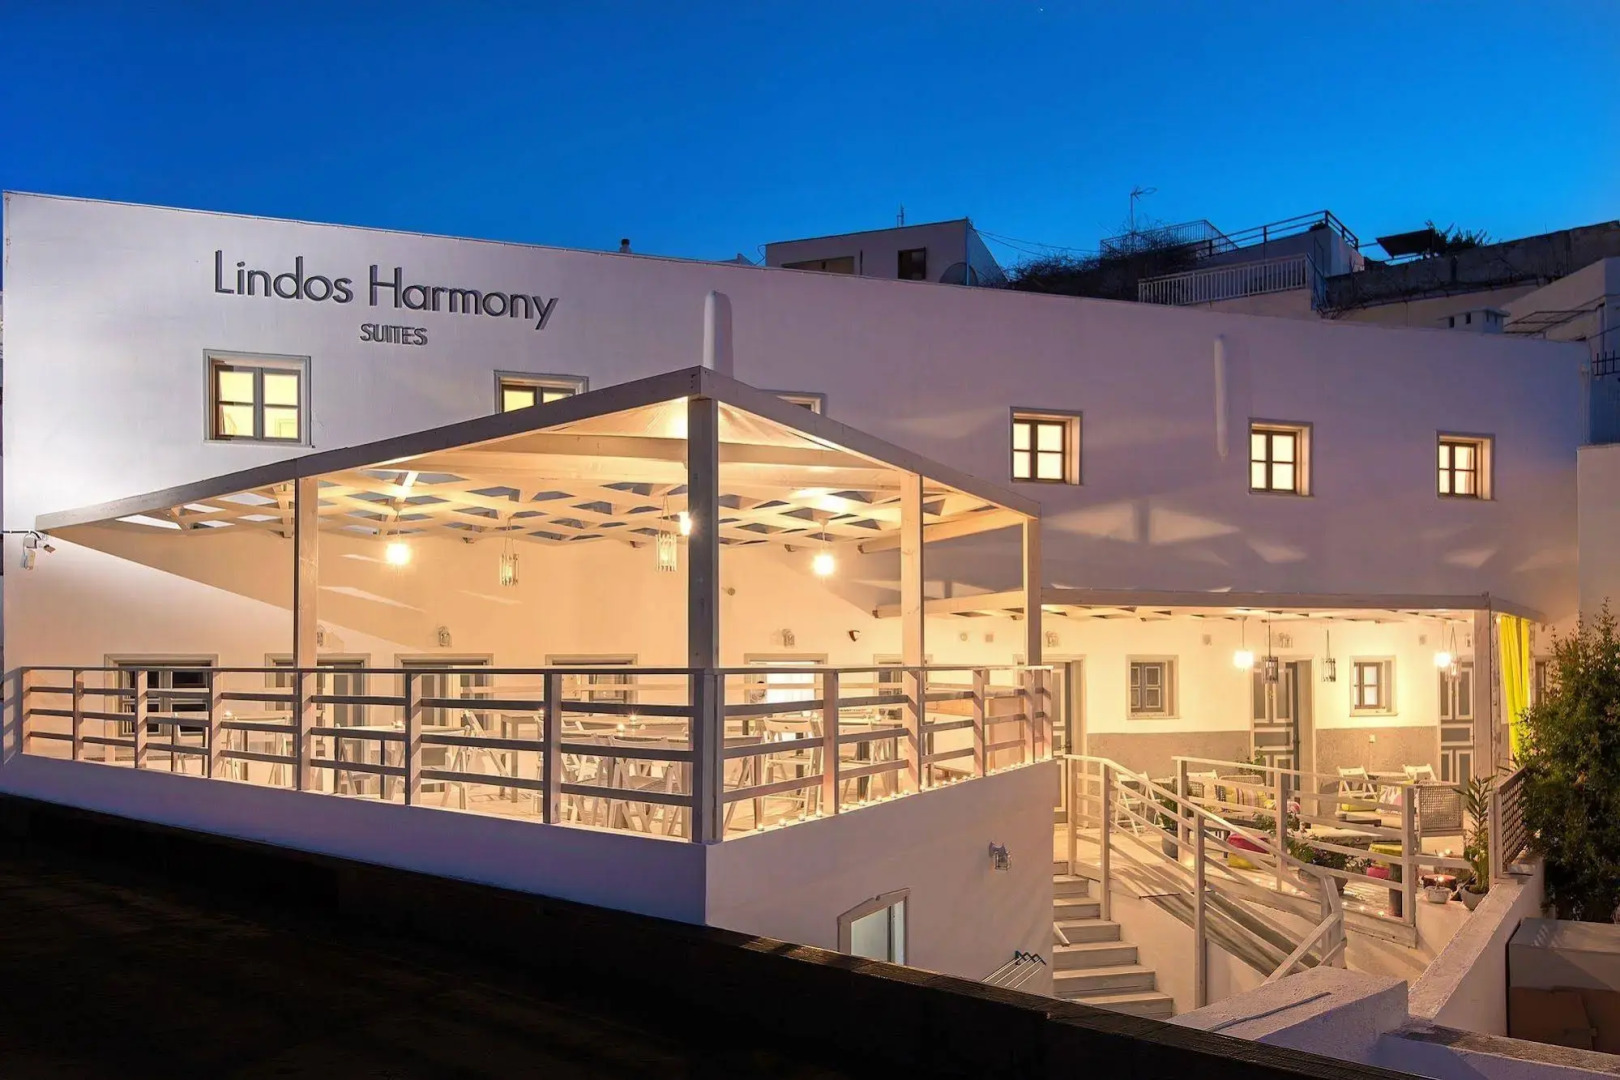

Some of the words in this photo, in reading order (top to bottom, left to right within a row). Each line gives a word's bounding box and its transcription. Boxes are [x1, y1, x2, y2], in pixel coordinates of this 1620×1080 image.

[214, 249, 353, 303] Lindos
[369, 264, 559, 330] Harmony
[360, 323, 428, 346] SUITES
